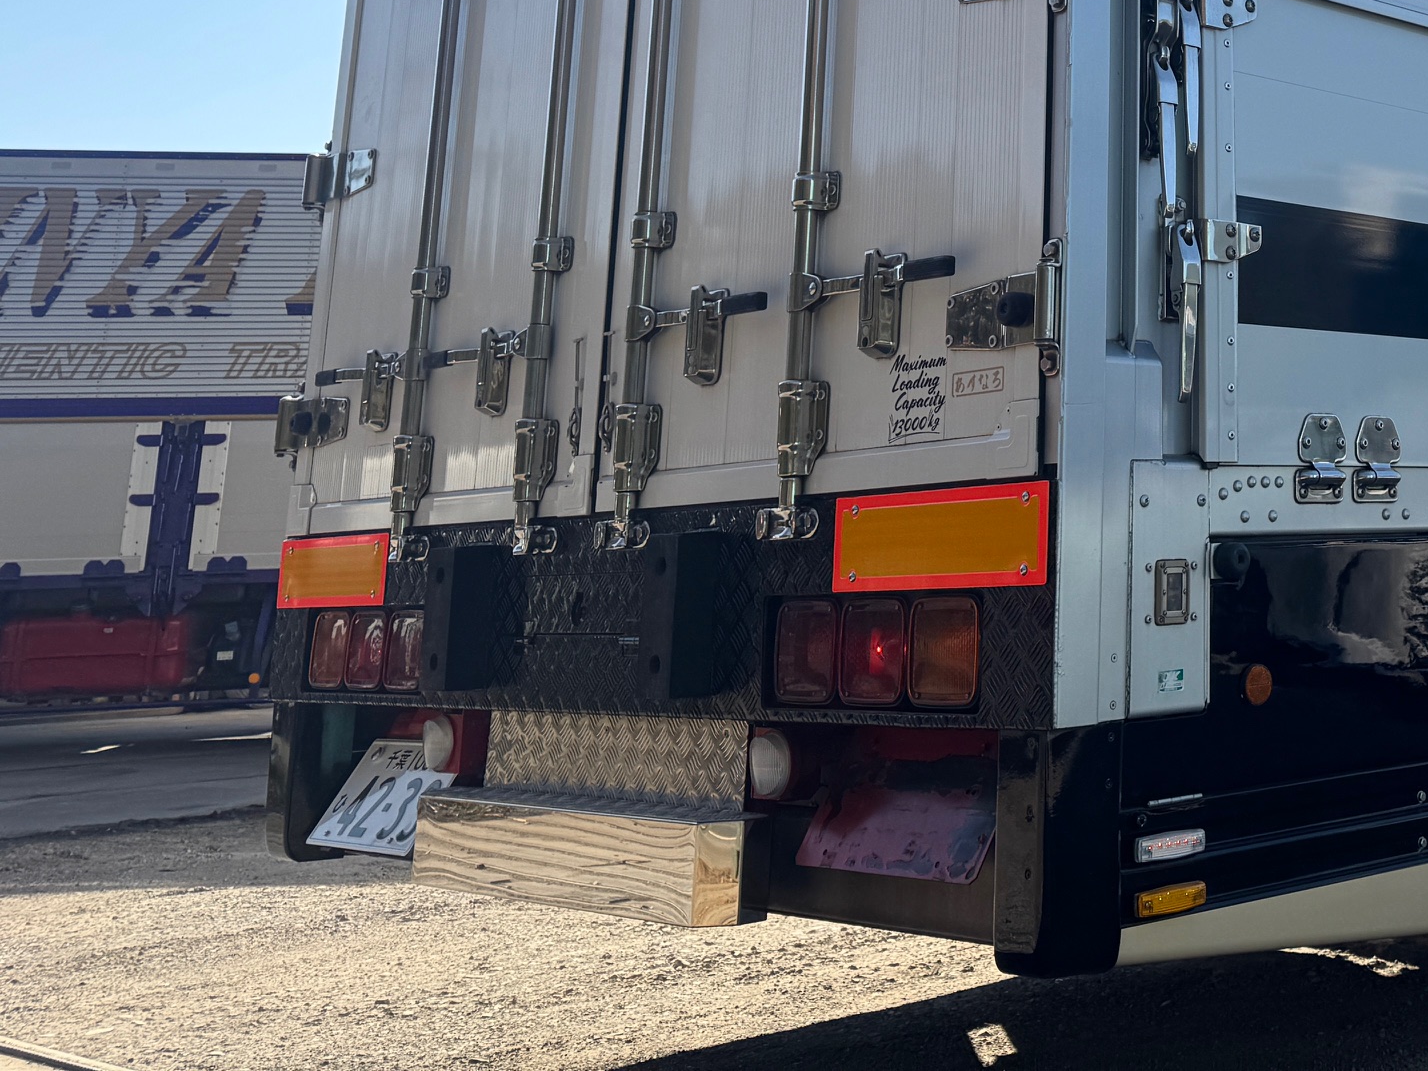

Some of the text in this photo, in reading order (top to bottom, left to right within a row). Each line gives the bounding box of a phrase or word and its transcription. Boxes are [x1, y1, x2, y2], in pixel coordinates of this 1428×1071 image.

[890, 354, 947, 375] Maximum
[891, 370, 941, 395] Loading
[955, 370, 1002, 393] あすなろ
[894, 391, 947, 417] Capacity
